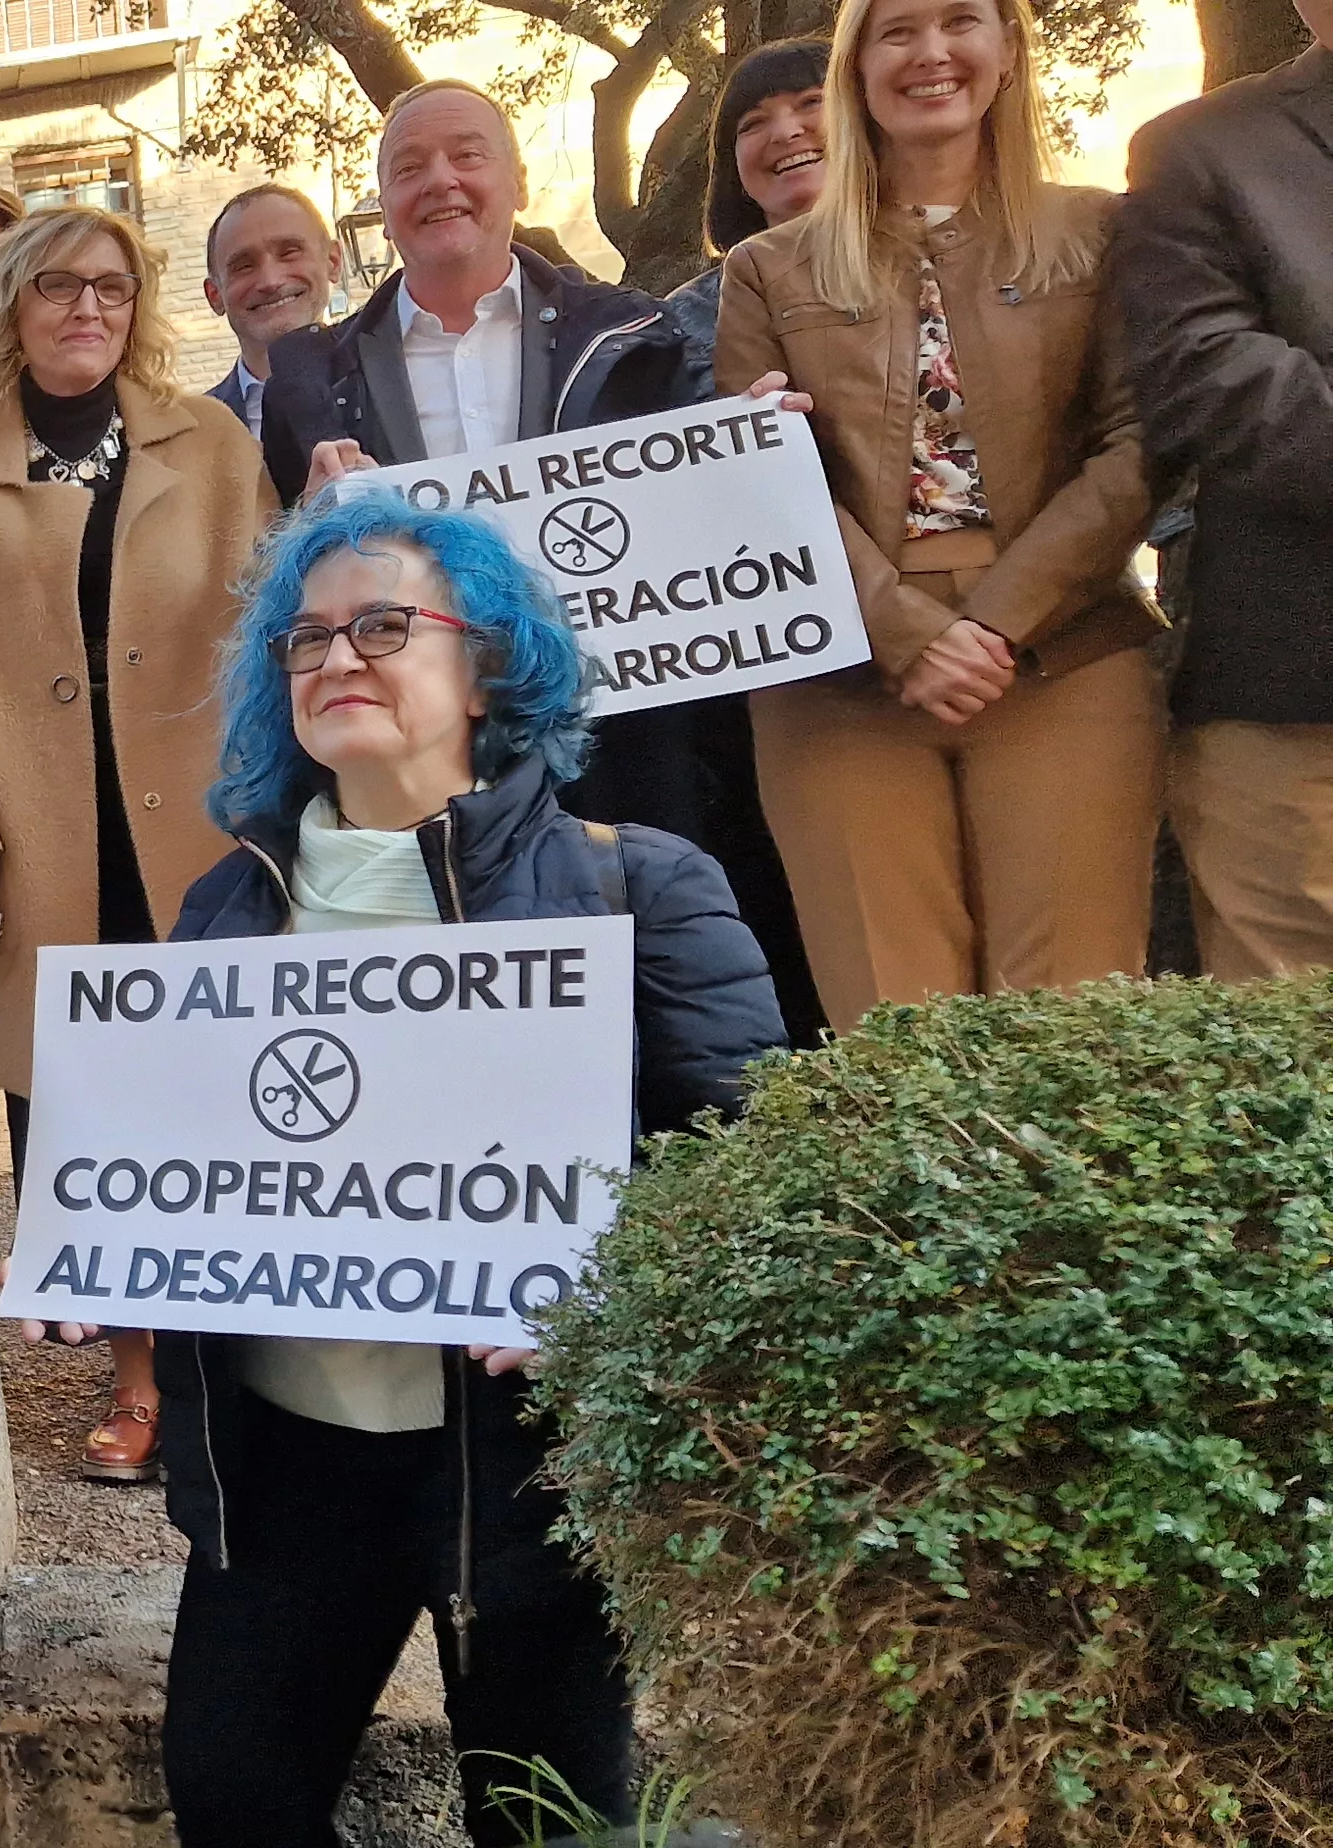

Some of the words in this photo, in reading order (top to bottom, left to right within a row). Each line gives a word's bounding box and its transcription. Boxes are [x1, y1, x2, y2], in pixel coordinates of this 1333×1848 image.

[463, 462, 530, 511] AL
[537, 408, 783, 496] RECORTE
[559, 543, 817, 632] ERACIÓN
[585, 612, 833, 693] ARROLLO
[69, 968, 165, 1023] NO
[175, 964, 255, 1021] AL
[272, 947, 585, 1018] RECORTE
[53, 1141, 581, 1225] COOPERACIÓN
[35, 1244, 111, 1297] AL
[124, 1245, 576, 1320] DESARROLLO
